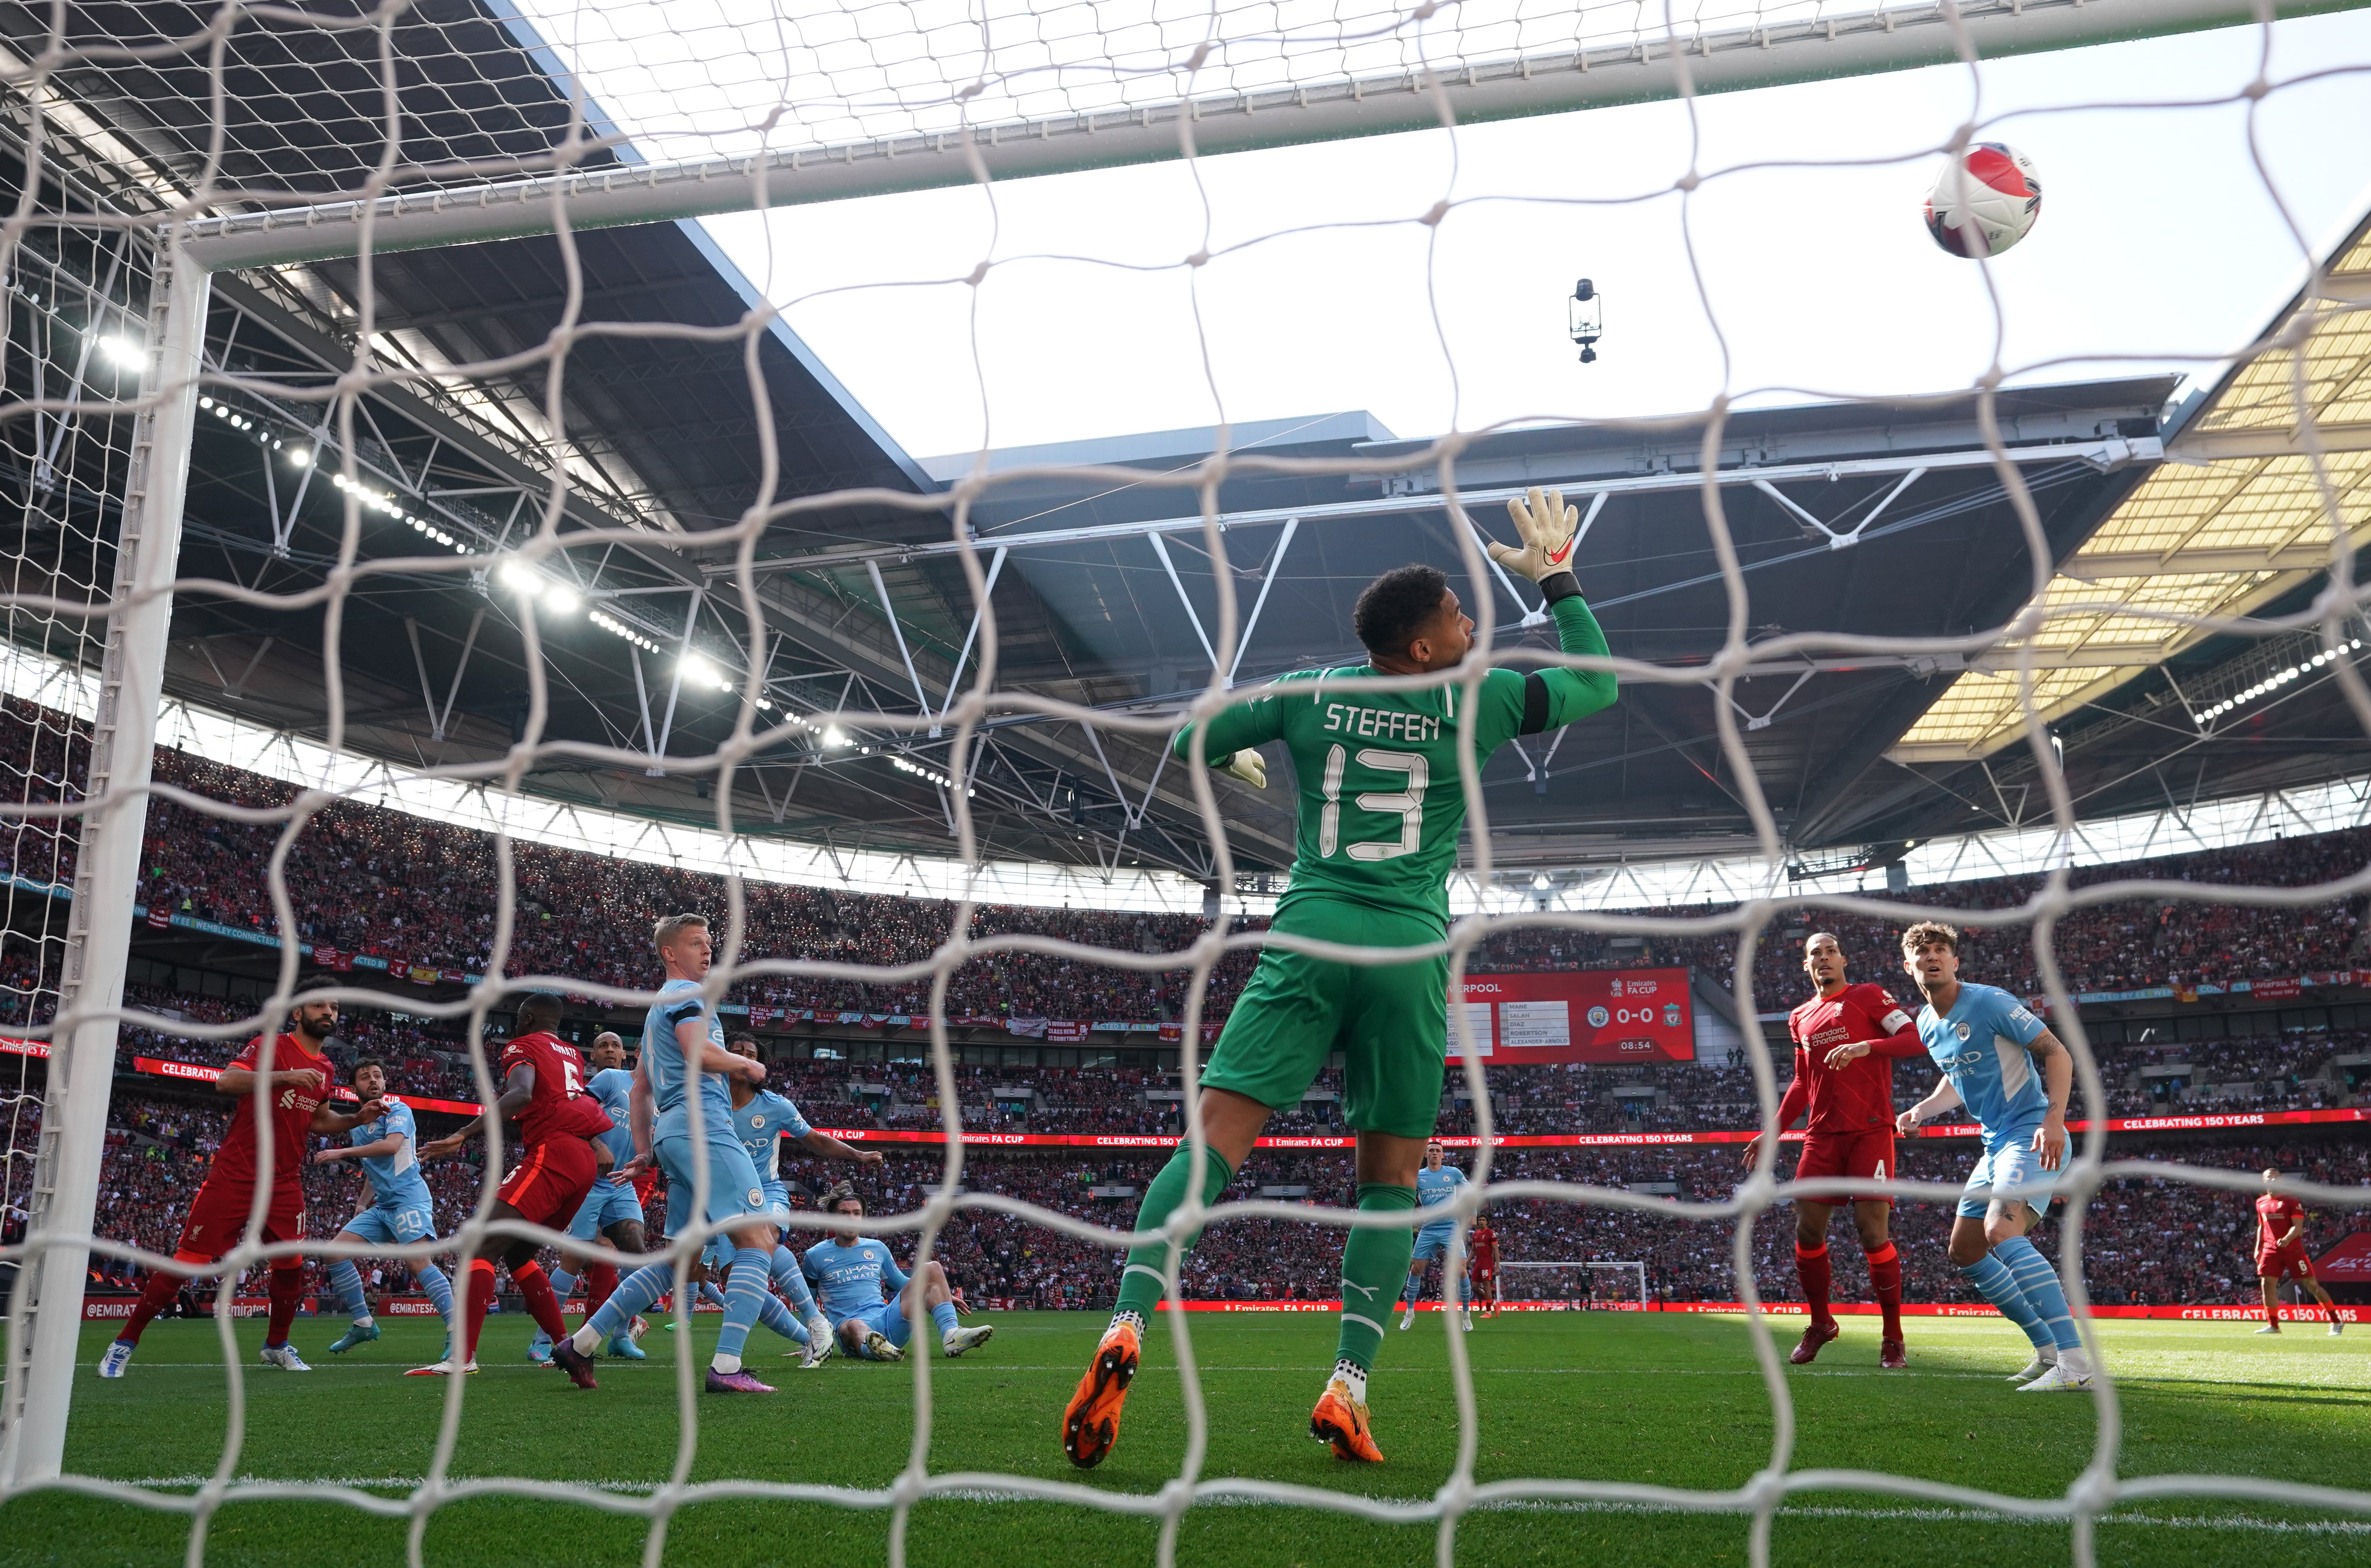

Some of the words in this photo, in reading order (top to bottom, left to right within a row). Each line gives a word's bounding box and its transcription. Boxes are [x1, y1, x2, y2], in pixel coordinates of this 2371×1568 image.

[1324, 703, 1441, 741] STEFFEN
[1318, 743, 1429, 861] 13
[181, 917, 191, 927] EE
[196, 920, 231, 935] WEMBLEY
[233, 929, 275, 946] CONNECTED
[378, 960, 388, 969] BY
[1617, 1008, 1653, 1023] 0-0
[1811, 1026, 1846, 1041] standard
[1812, 1032, 1850, 1047] chartered
[550, 1041, 577, 1060] KONATE
[1621, 1041, 1650, 1050] 08:54
[503, 1049, 523, 1059] Expedia
[295, 1102, 317, 1112] charter
[297, 1095, 319, 1107] standa
[386, 1115, 407, 1124] NEXEN
[2124, 1117, 2202, 1129] CELEBRATING
[2205, 1117, 2224, 1126] 150
[2226, 1114, 2264, 1125] YEARS
[1779, 1132, 1806, 1141] mirate
[1954, 1126, 1983, 1135] Emira
[958, 1134, 990, 1143] Emirates
[1005, 1135, 1024, 1143] CUP
[1097, 1136, 1158, 1145] CELEBRATING
[1579, 1135, 1643, 1144] CELEBRATING
[1645, 1135, 1661, 1143] 150
[1663, 1134, 1693, 1143] YEARS
[1873, 1159, 1887, 1184] 4
[296, 1209, 306, 1235] 11
[395, 1209, 423, 1234] 20
[824, 1263, 880, 1280] ETIHAD
[2298, 1259, 2308, 1271] 6
[837, 1271, 875, 1284] AIRWAYS
[1948, 1308, 2003, 1317] Emirates
[2182, 1309, 2289, 1321] CELEBRATIG
[2292, 1308, 2315, 1321] 150
